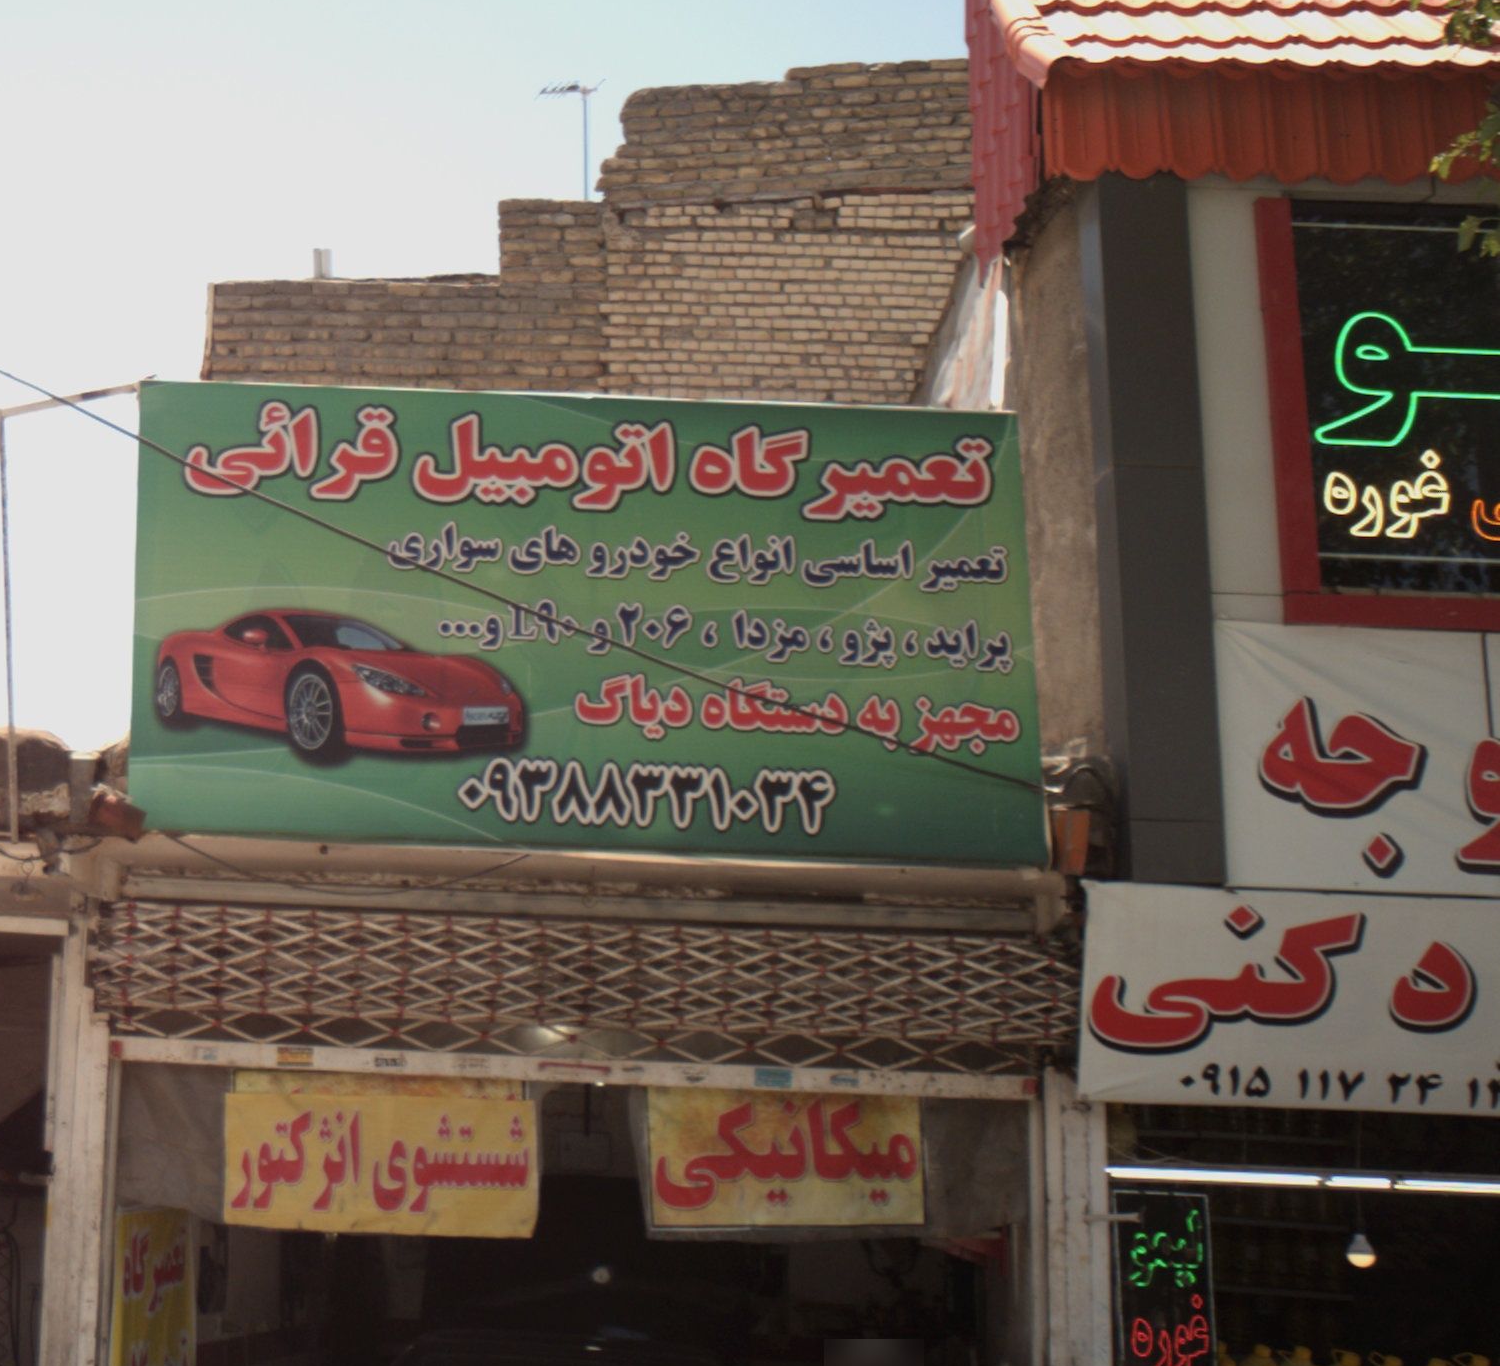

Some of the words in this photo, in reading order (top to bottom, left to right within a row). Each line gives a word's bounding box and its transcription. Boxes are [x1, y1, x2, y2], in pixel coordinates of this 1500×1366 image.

[185, 401, 399, 500] قرائی
[412, 412, 675, 512] اتومبیل
[1324, 449, 1450, 538] غوره
[387, 521, 503, 572] سواری
[508, 525, 581, 574] های
[585, 531, 700, 580] خودرو
[707, 533, 795, 583] انواع
[802, 538, 914, 587] اساسی
[920, 545, 1008, 591] تعمیر
[586, 618, 612, 655] و
[616, 602, 693, 649] ۲۰۶
[574, 673, 693, 740] دیاگ
[700, 677, 848, 735] دستگاه
[856, 693, 901, 750] به
[907, 693, 1020, 755] مجهز
[456, 757, 836, 835] ۰۹۳۸۸۳۳۱۰۳۴
[1088, 903, 1367, 1055] کنی
[1388, 938, 1478, 1036] د
[1180, 1062, 1271, 1098] ۰۹۱۵
[1297, 1068, 1365, 1102] ۱۱۷
[1386, 1072, 1443, 1107] ۲۴
[229, 1109, 361, 1211] انژکتور
[371, 1113, 530, 1213] شستشوی
[654, 1095, 918, 1211] میکانیکی
